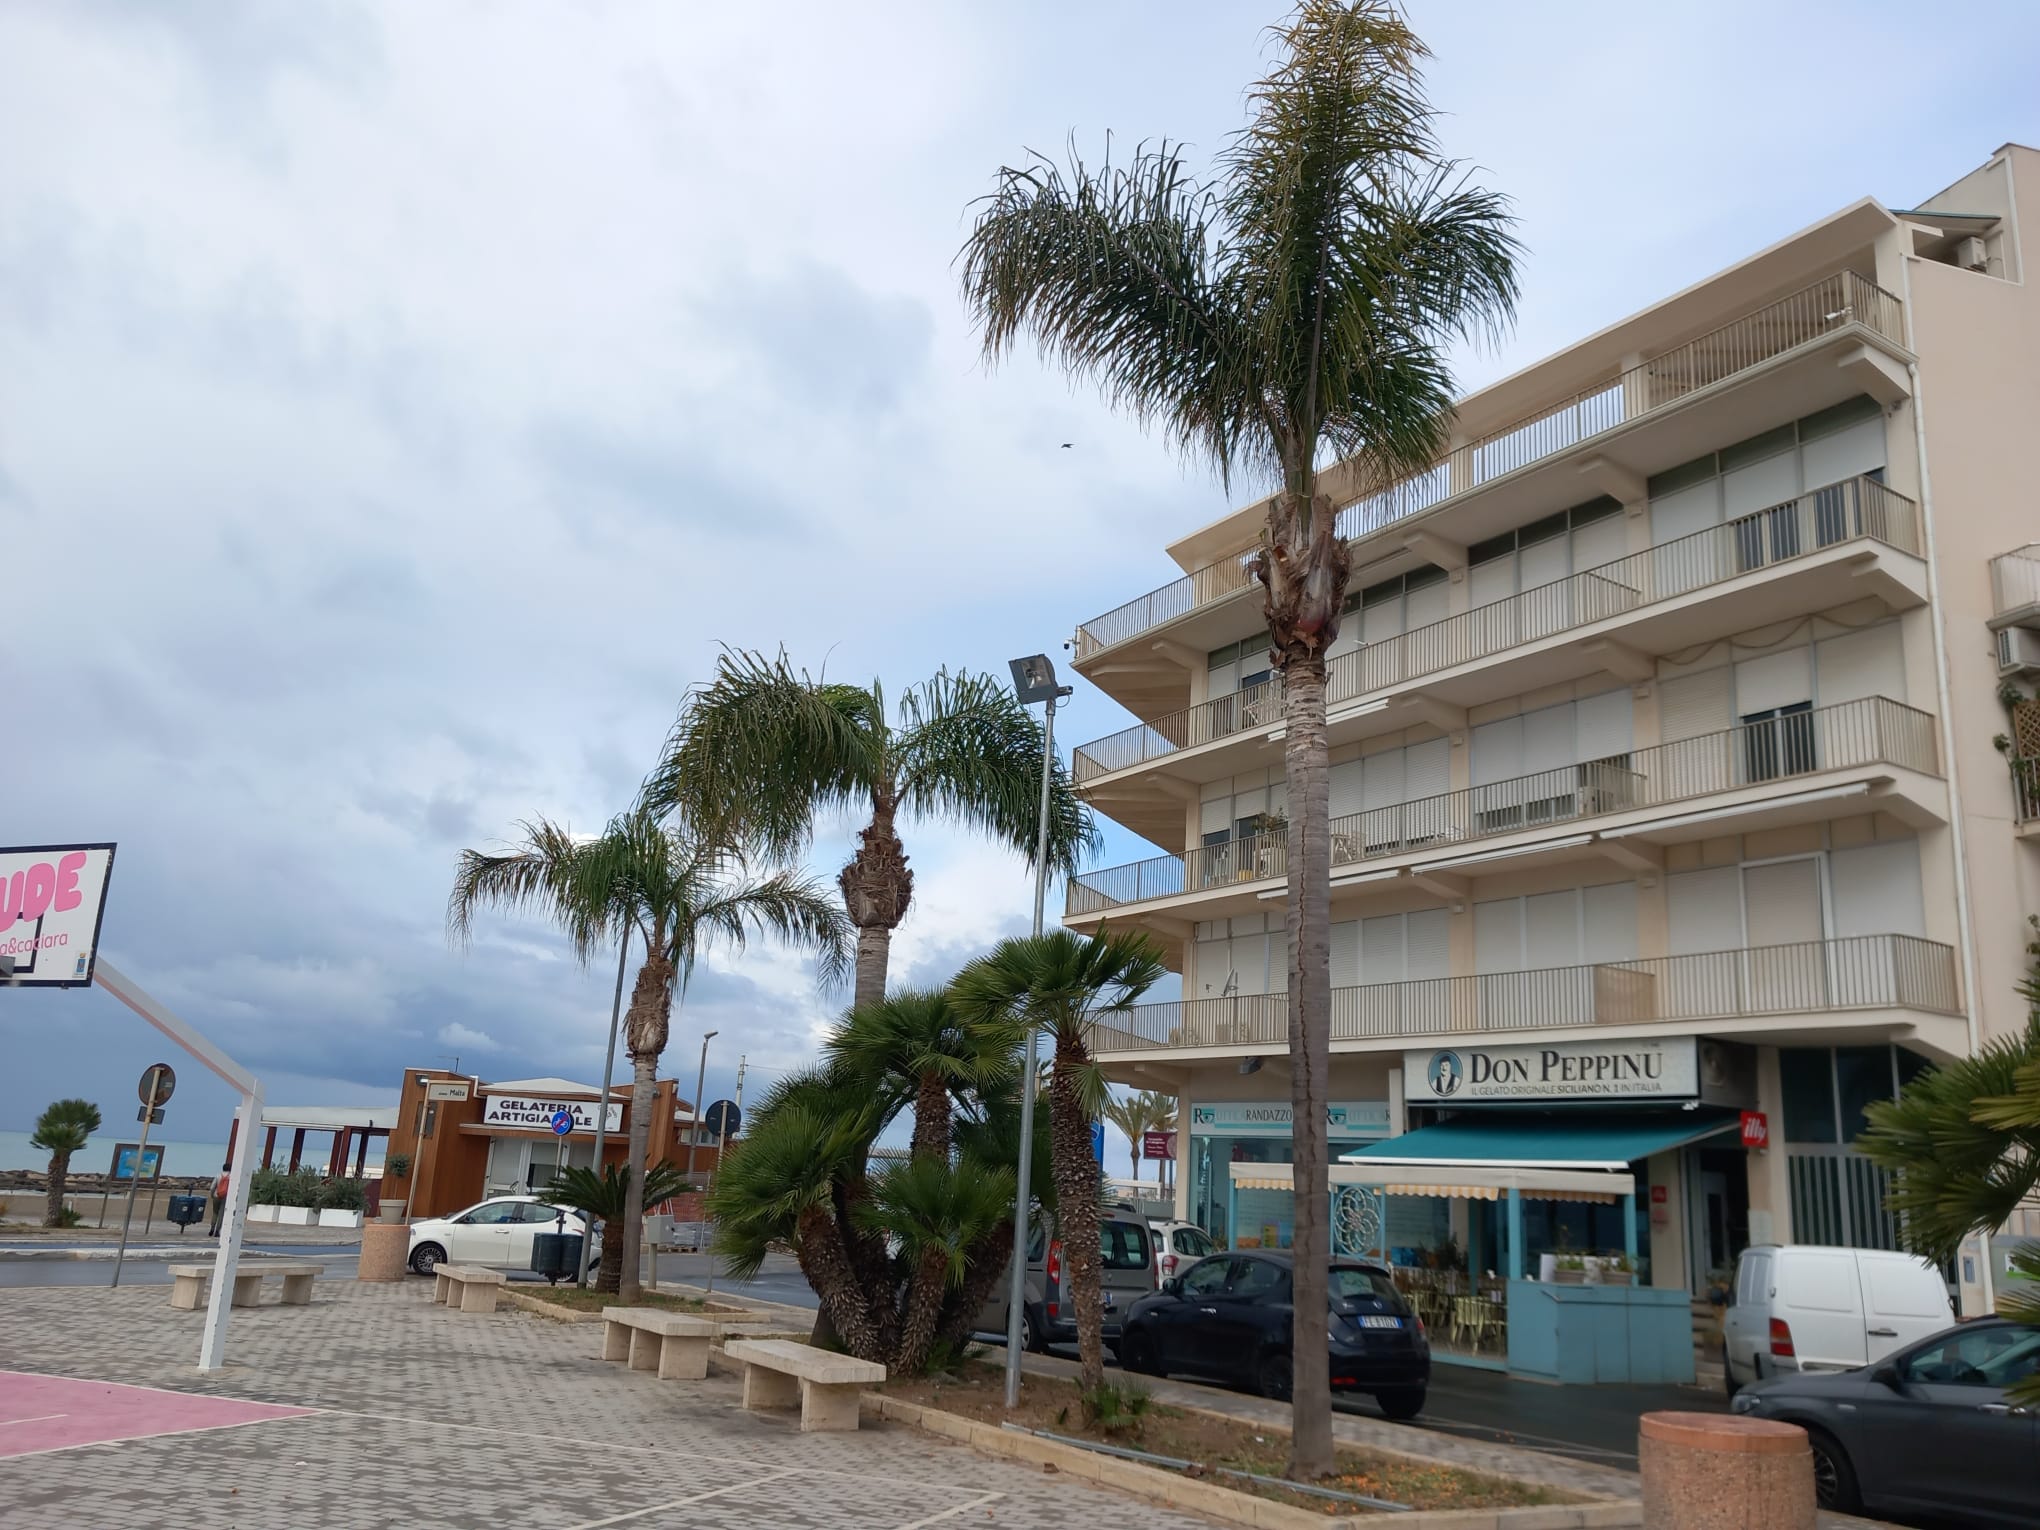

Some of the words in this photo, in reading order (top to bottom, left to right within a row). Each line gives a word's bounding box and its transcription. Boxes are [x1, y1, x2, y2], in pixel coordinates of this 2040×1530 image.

[1470, 1053, 1529, 1083] DON
[1539, 1050, 1663, 1081] PEPPINU
[1480, 1086, 1510, 1095] GELATO
[1511, 1085, 1556, 1095] ORIGINALE
[1557, 1084, 1600, 1094] SICILIANO
[1621, 1083, 1630, 1092] IN
[1633, 1082, 1662, 1092] ITALIA
[500, 1100, 583, 1114] GELATERIA
[488, 1111, 592, 1126] ARTIGIALE
[1246, 1109, 1293, 1121] RANDAZZO
